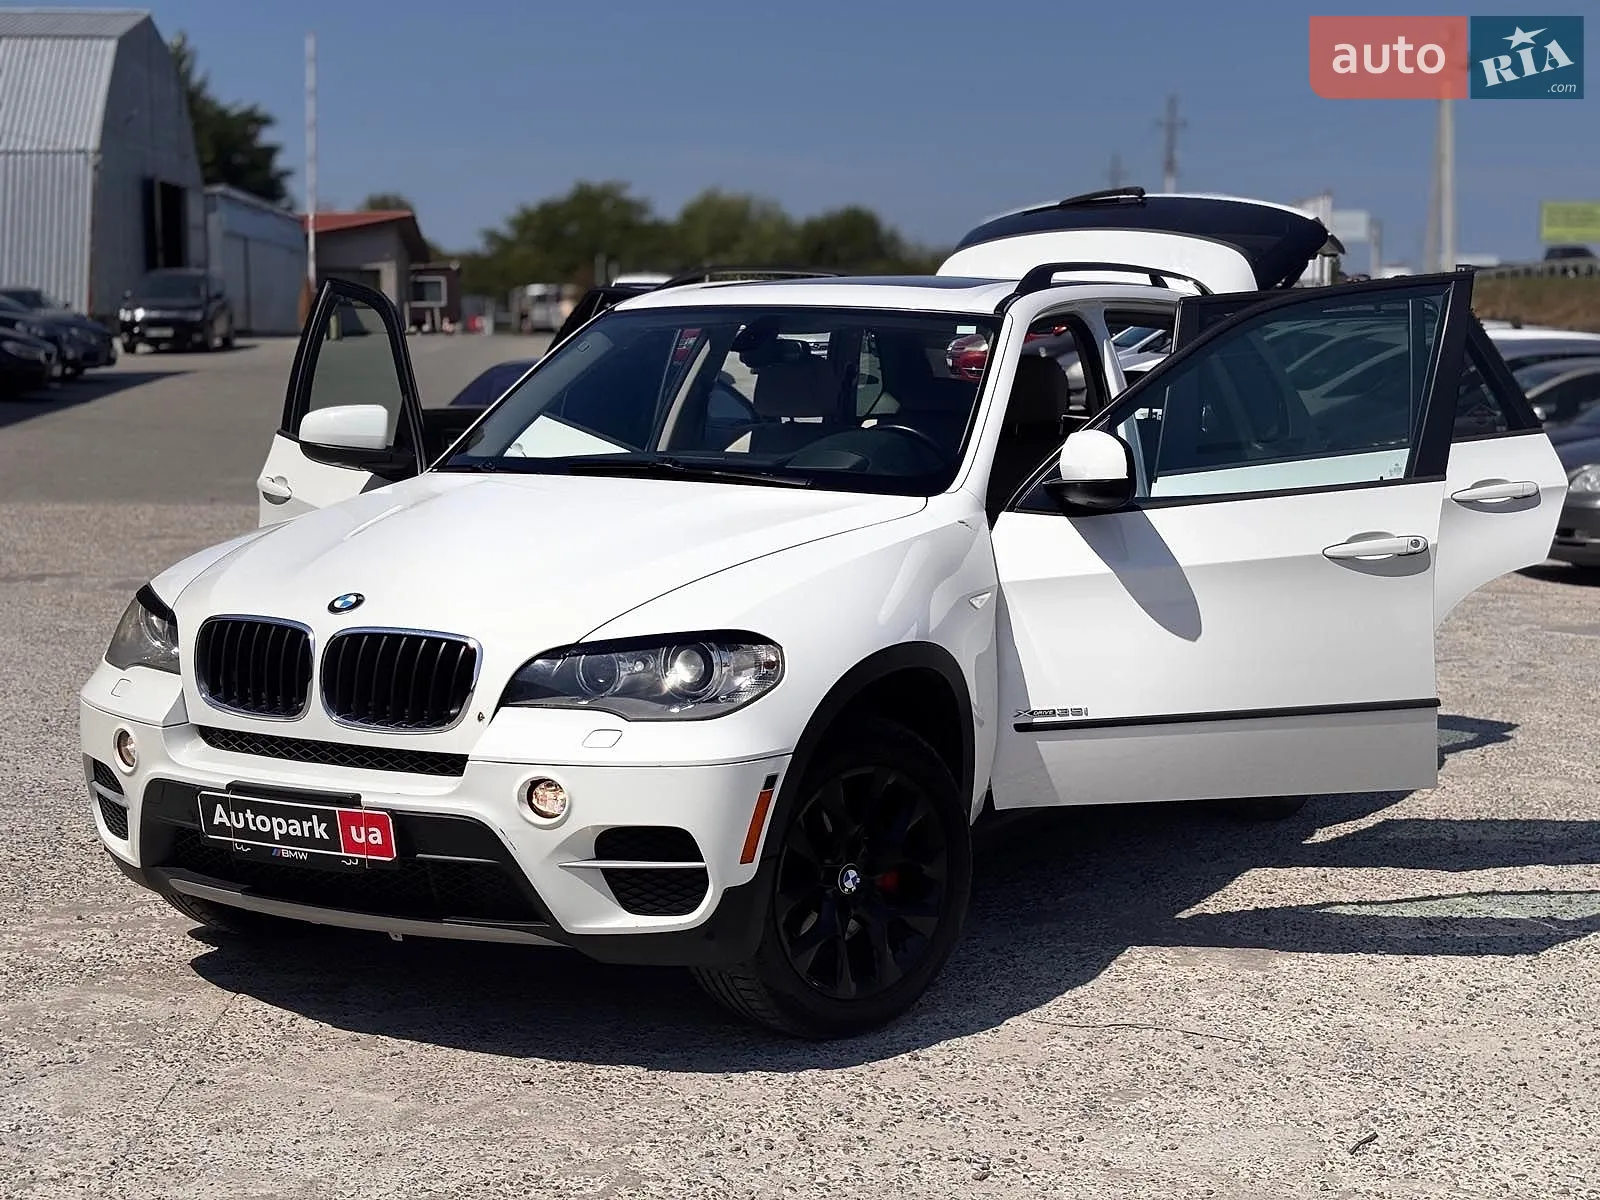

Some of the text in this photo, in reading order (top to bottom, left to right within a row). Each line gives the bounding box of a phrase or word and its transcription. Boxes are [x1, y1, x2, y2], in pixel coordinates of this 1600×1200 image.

[213, 803, 383, 846] Autopark ua
[281, 849, 309, 861] BMW
